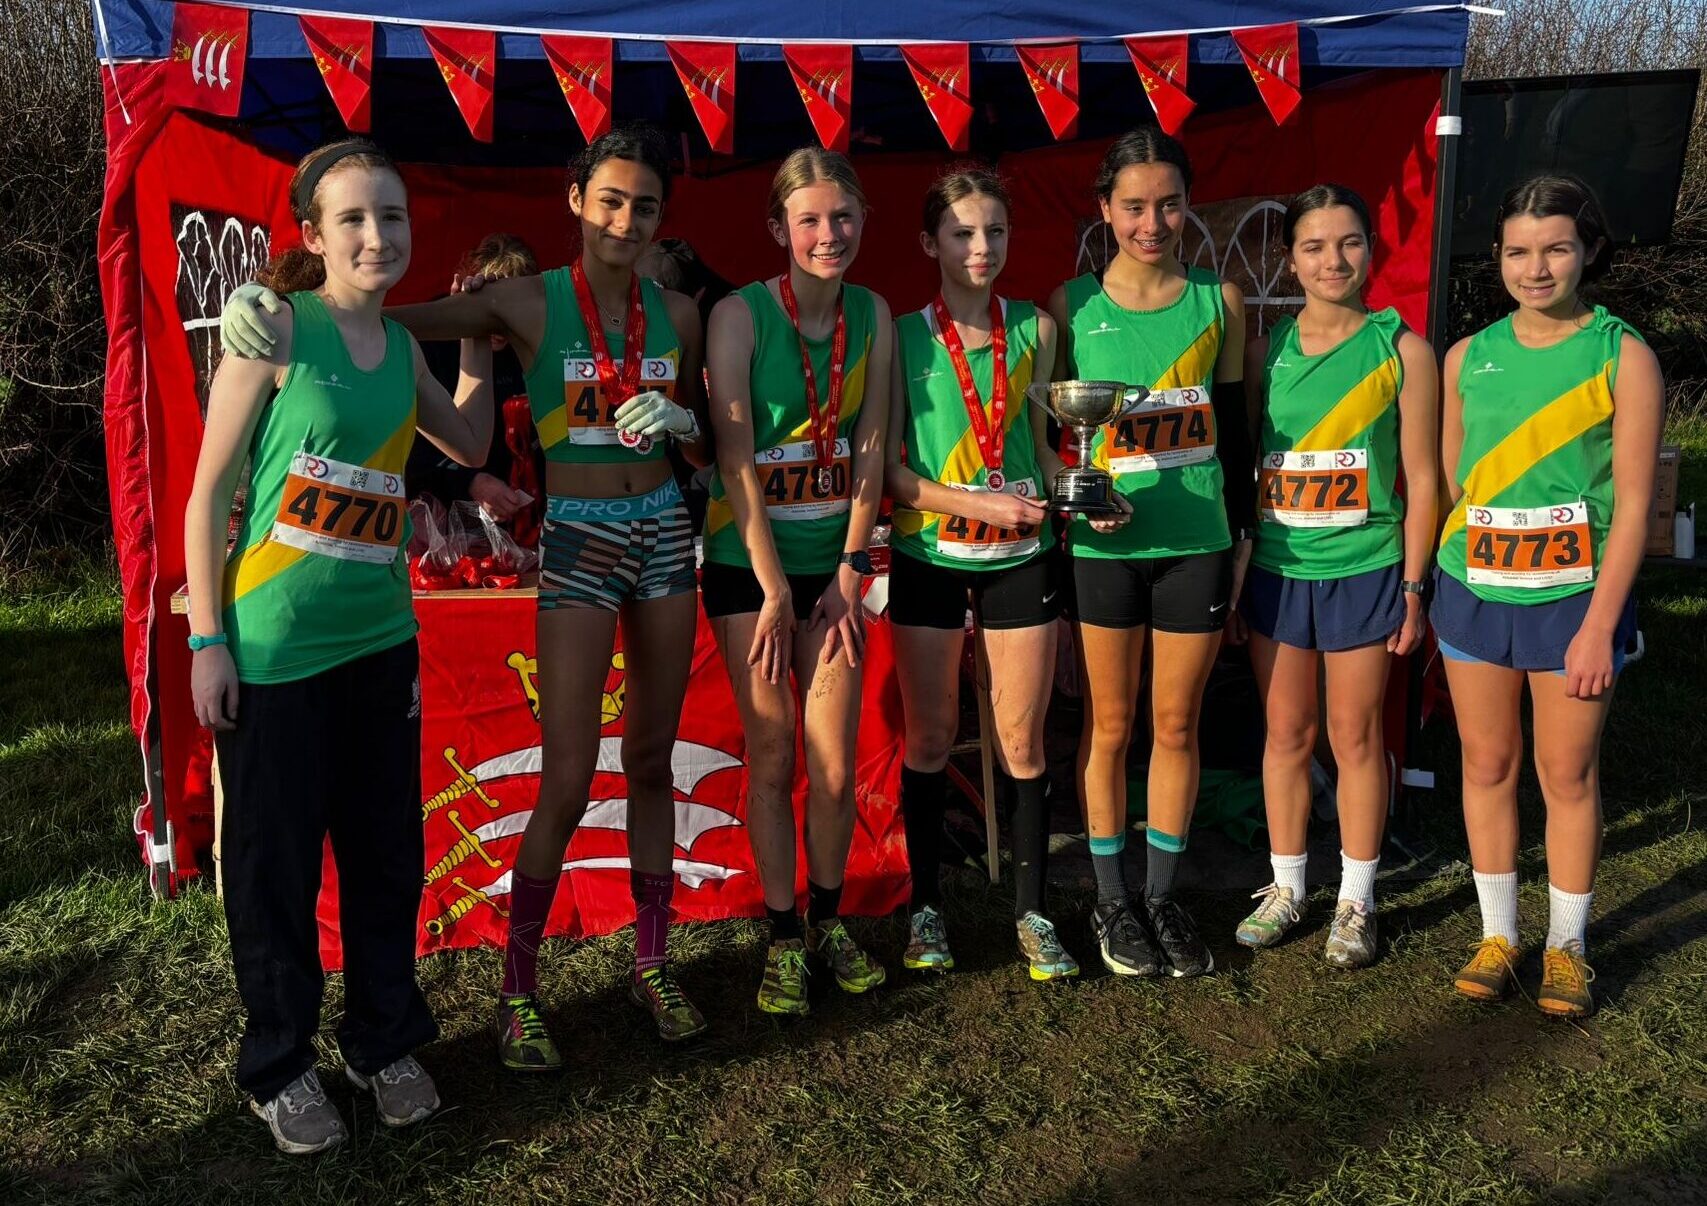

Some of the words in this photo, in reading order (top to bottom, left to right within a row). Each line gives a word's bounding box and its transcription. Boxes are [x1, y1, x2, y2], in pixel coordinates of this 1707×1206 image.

[1112, 410, 1209, 453] 4774
[763, 462, 846, 502] 4780
[1264, 473, 1360, 508] 4772
[288, 485, 398, 542] 4770
[558, 500, 631, 517] PRO
[1472, 530, 1581, 568] 4773
